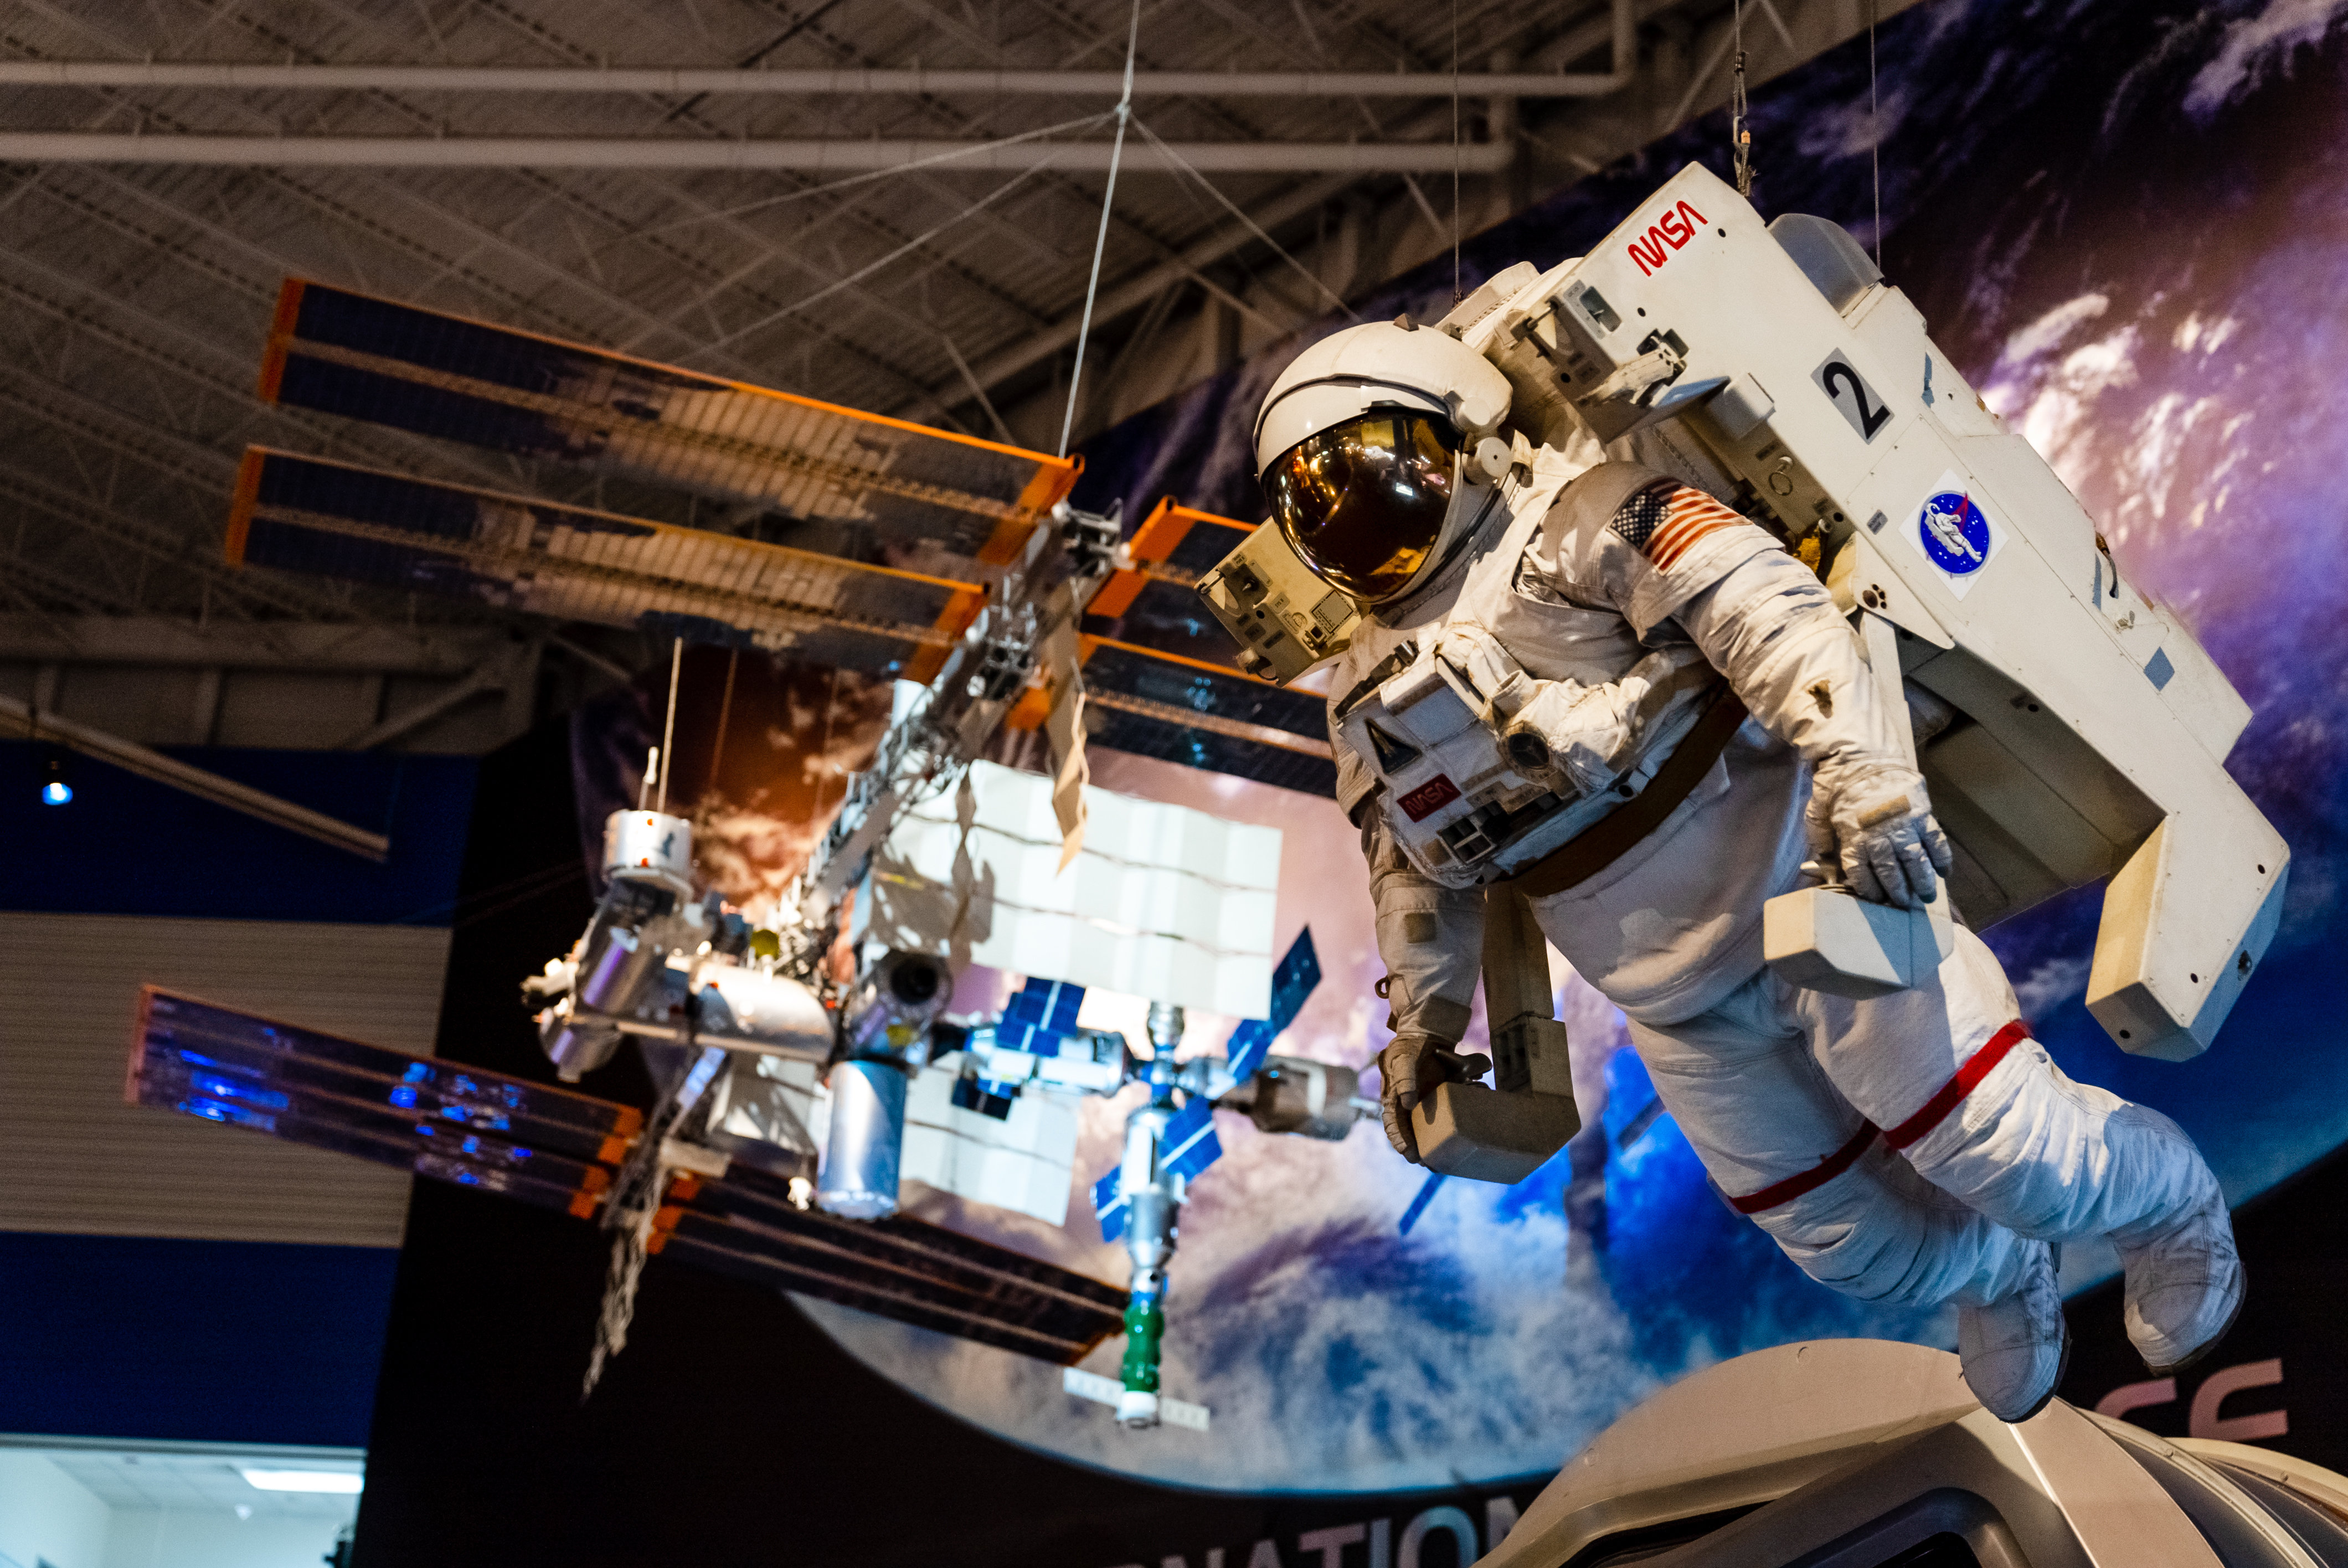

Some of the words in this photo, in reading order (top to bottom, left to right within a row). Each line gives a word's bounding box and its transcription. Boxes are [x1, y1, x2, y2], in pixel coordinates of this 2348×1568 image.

[1627, 200, 1708, 277] NASA
[1822, 362, 1889, 439] 2
[1405, 783, 1453, 813] NASA
